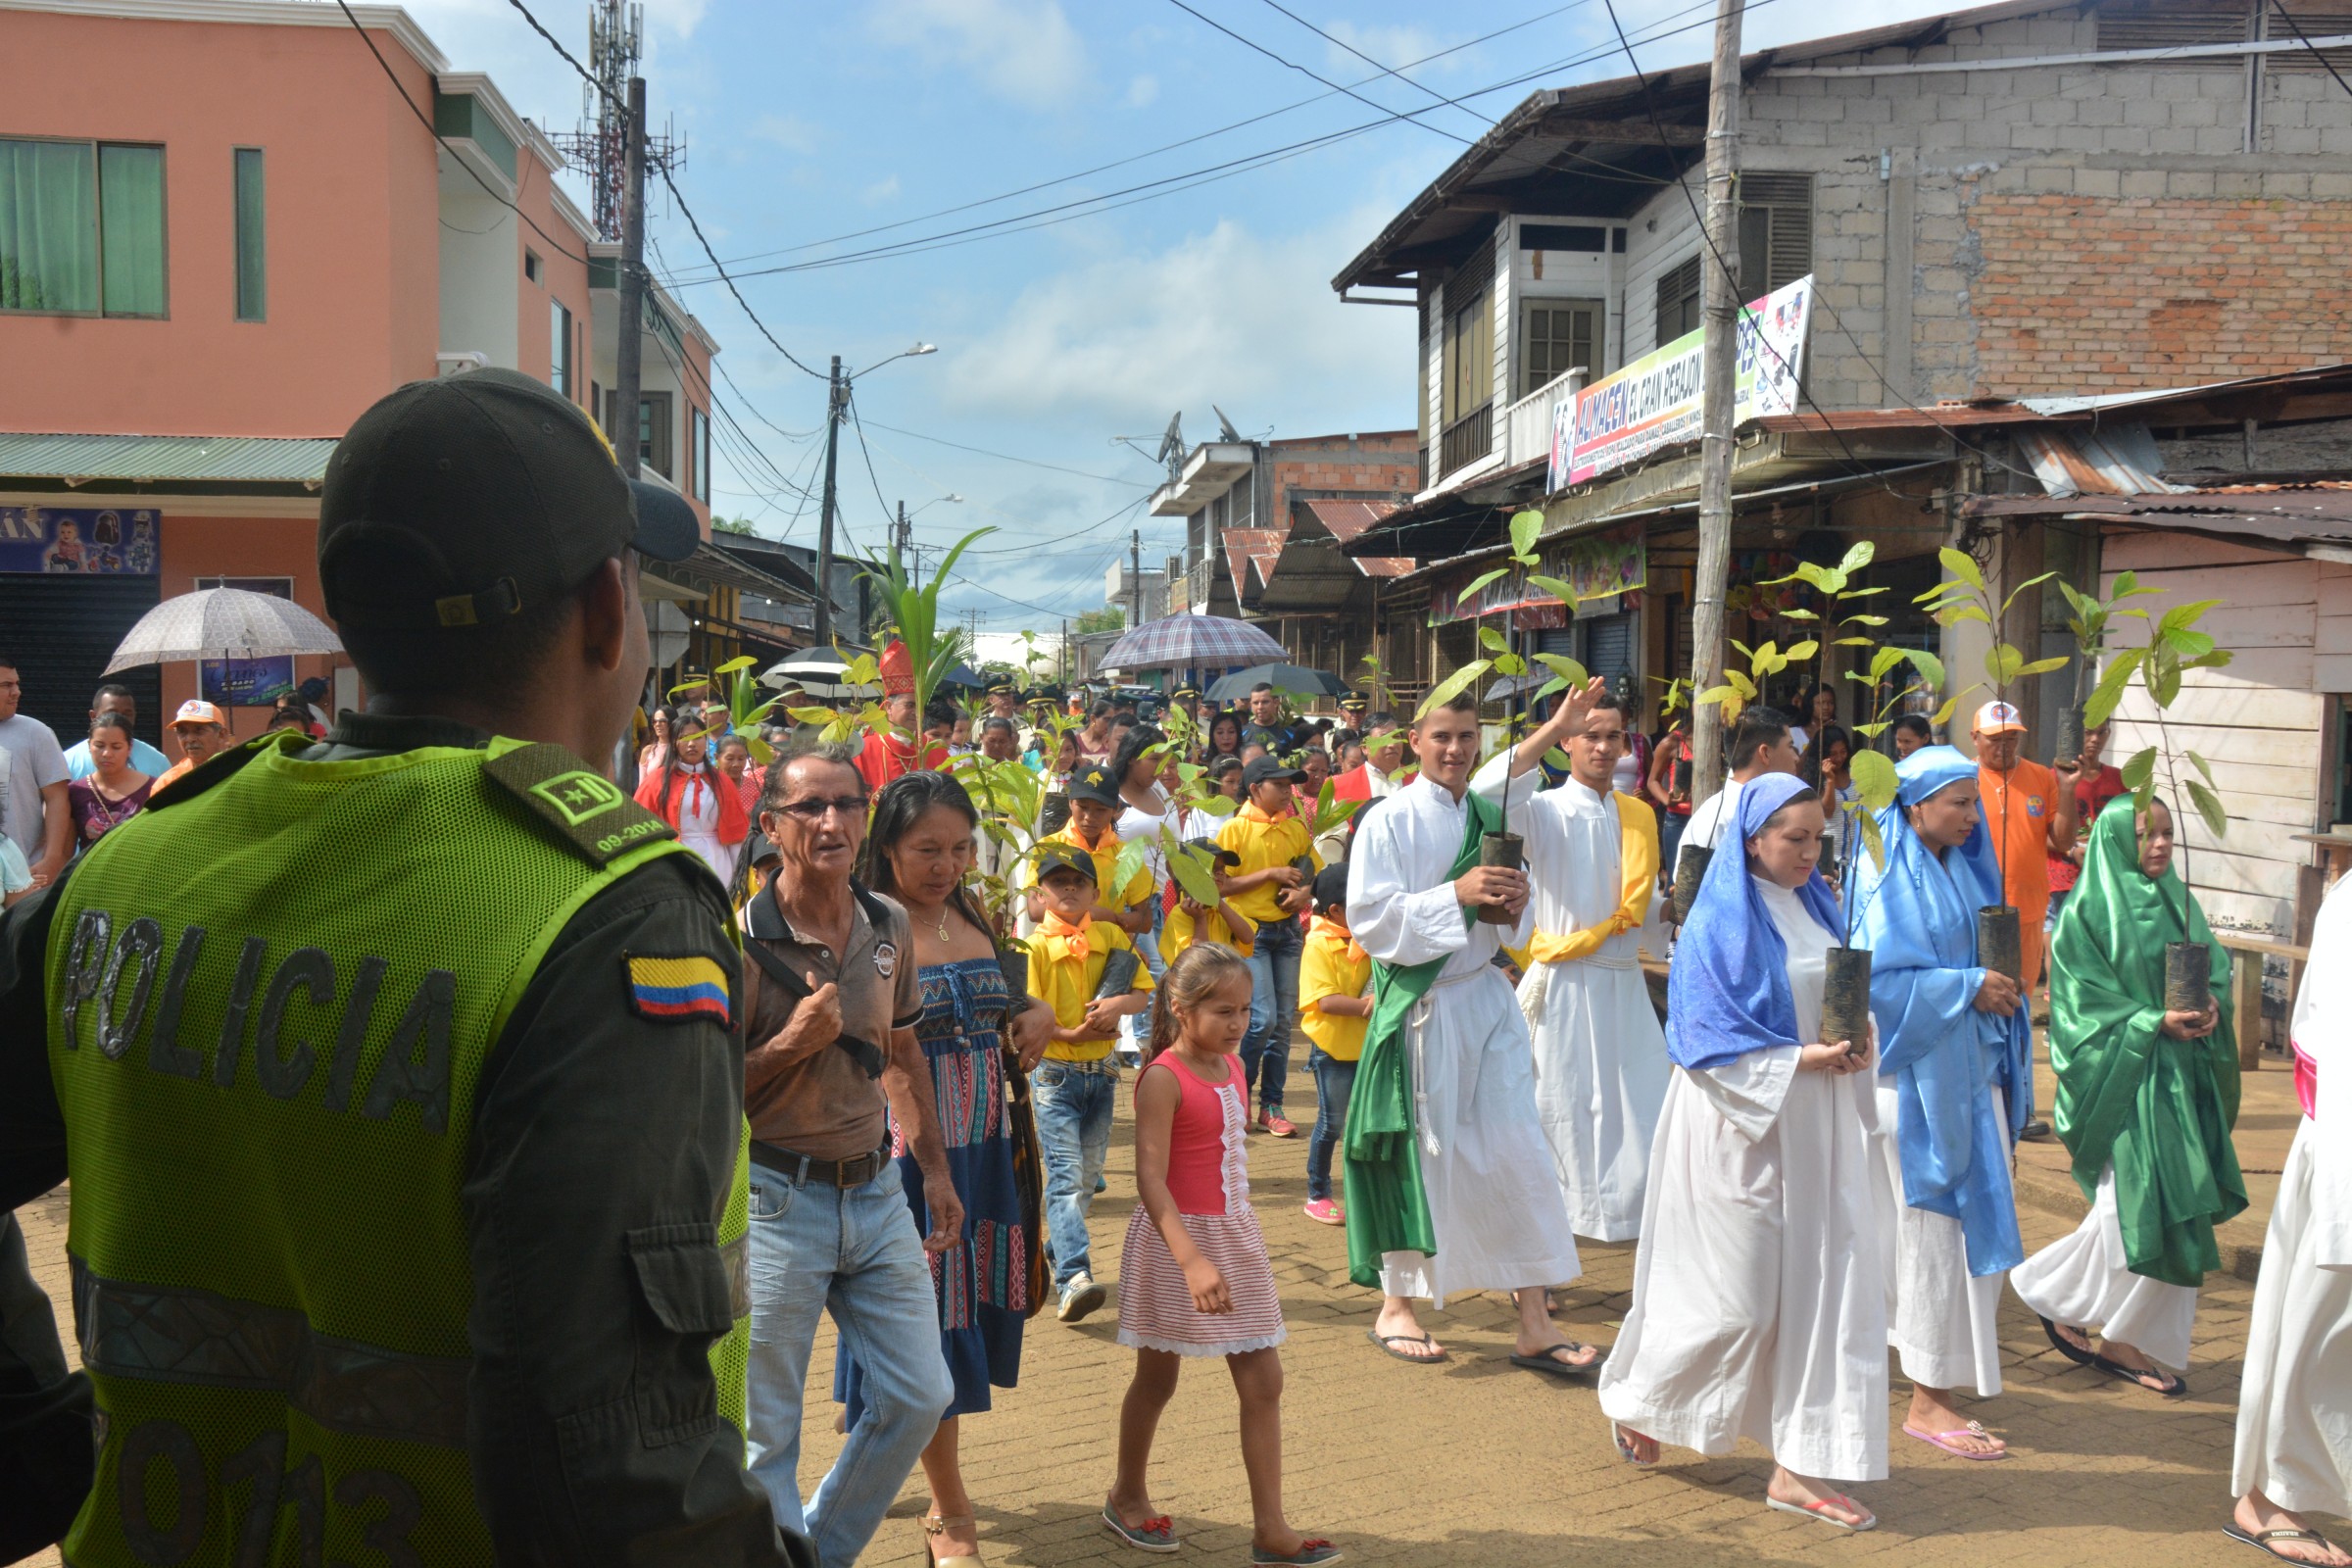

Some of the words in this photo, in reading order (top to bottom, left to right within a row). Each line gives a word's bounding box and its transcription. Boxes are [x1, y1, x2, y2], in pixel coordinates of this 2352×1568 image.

[1576, 378, 1630, 446] ALMACEN
[1628, 381, 1639, 423] EL
[1640, 370, 1663, 418] GRAN
[1663, 351, 1703, 409] REBAJON
[596, 819, 664, 853] 09-2014
[64, 909, 457, 1136] POLICIA
